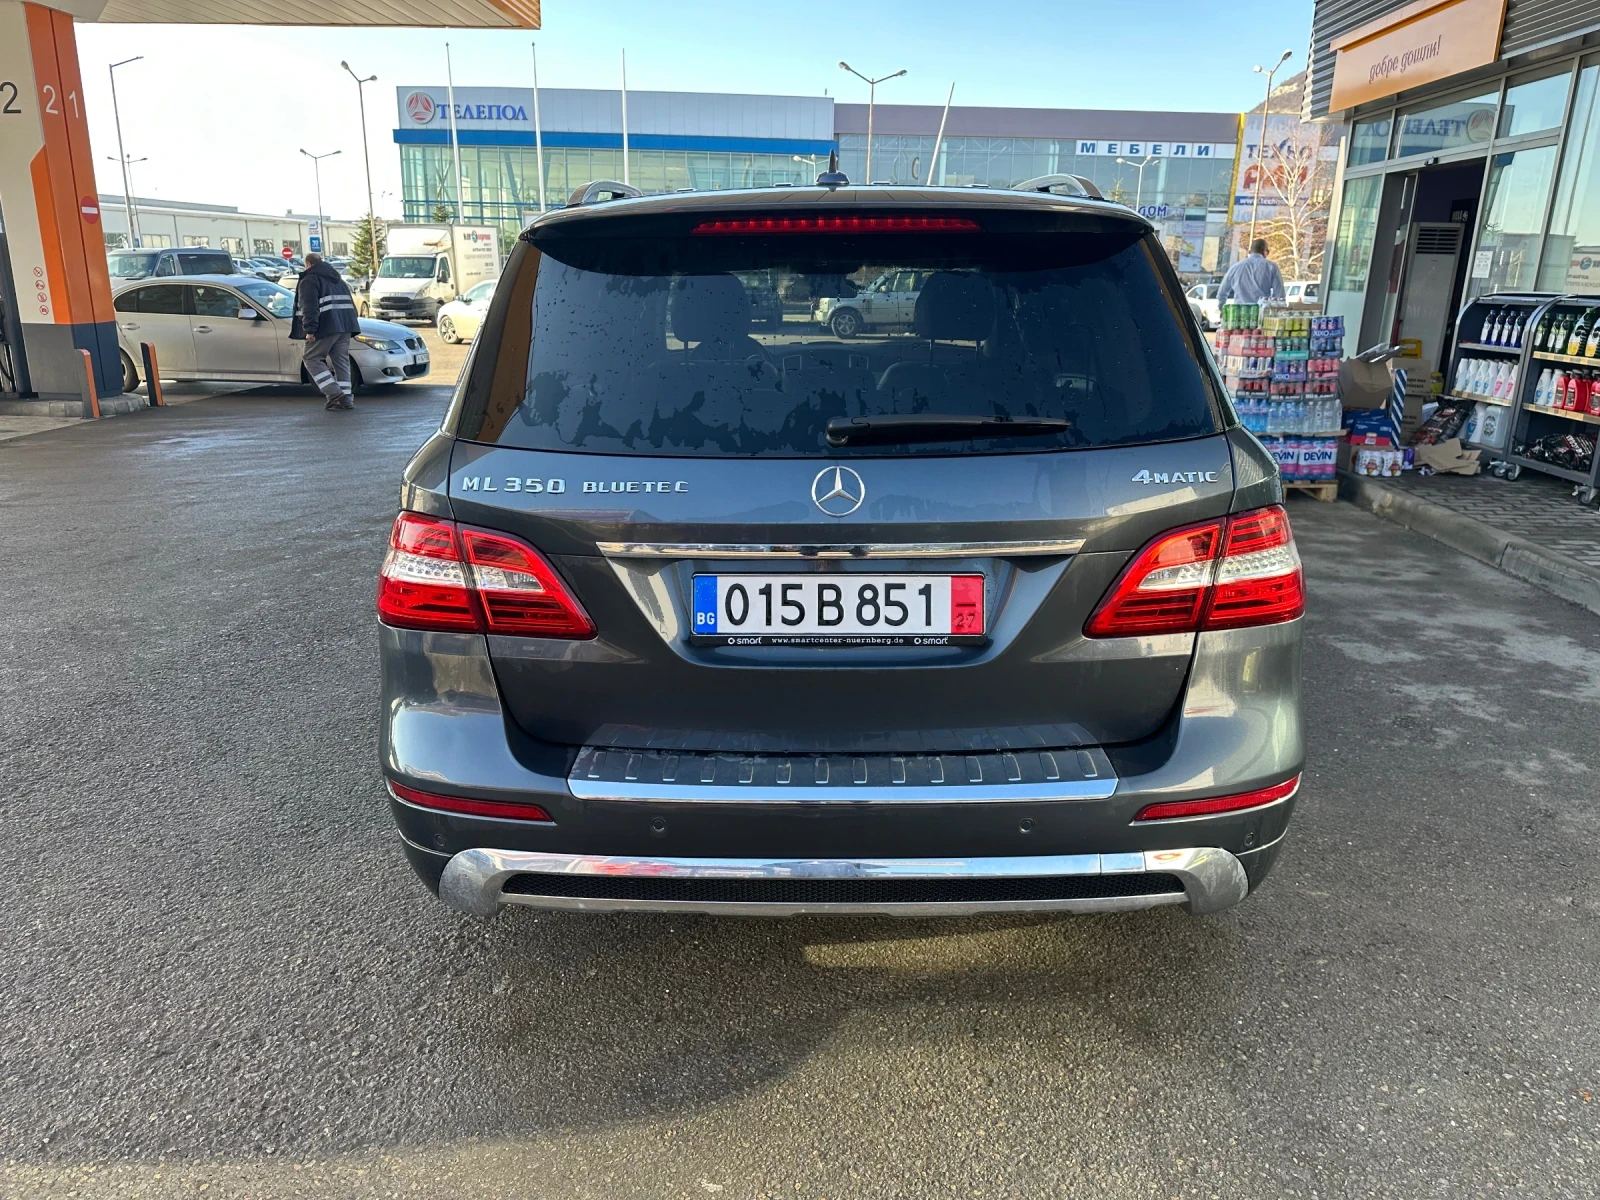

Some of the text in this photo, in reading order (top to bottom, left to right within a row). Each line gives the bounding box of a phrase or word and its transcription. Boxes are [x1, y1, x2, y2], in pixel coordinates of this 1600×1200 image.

[0, 81, 21, 113] 2
[43, 84, 59, 115] 2
[69, 90, 79, 118] 1
[436, 103, 528, 121] ТЕЛЕПОЛ
[1080, 142, 1210, 156] МЕБЕЛИ
[1273, 451, 1295, 461] EVIN
[1303, 451, 1332, 461] DEVIN
[1131, 469, 1218, 484] 4MATIC
[462, 477, 689, 494] ML 350 BLUETEC
[697, 612, 715, 625] BG
[956, 613, 976, 627] 27
[736, 637, 948, 645] smart www.smartcenter-nuernberg.de smart
